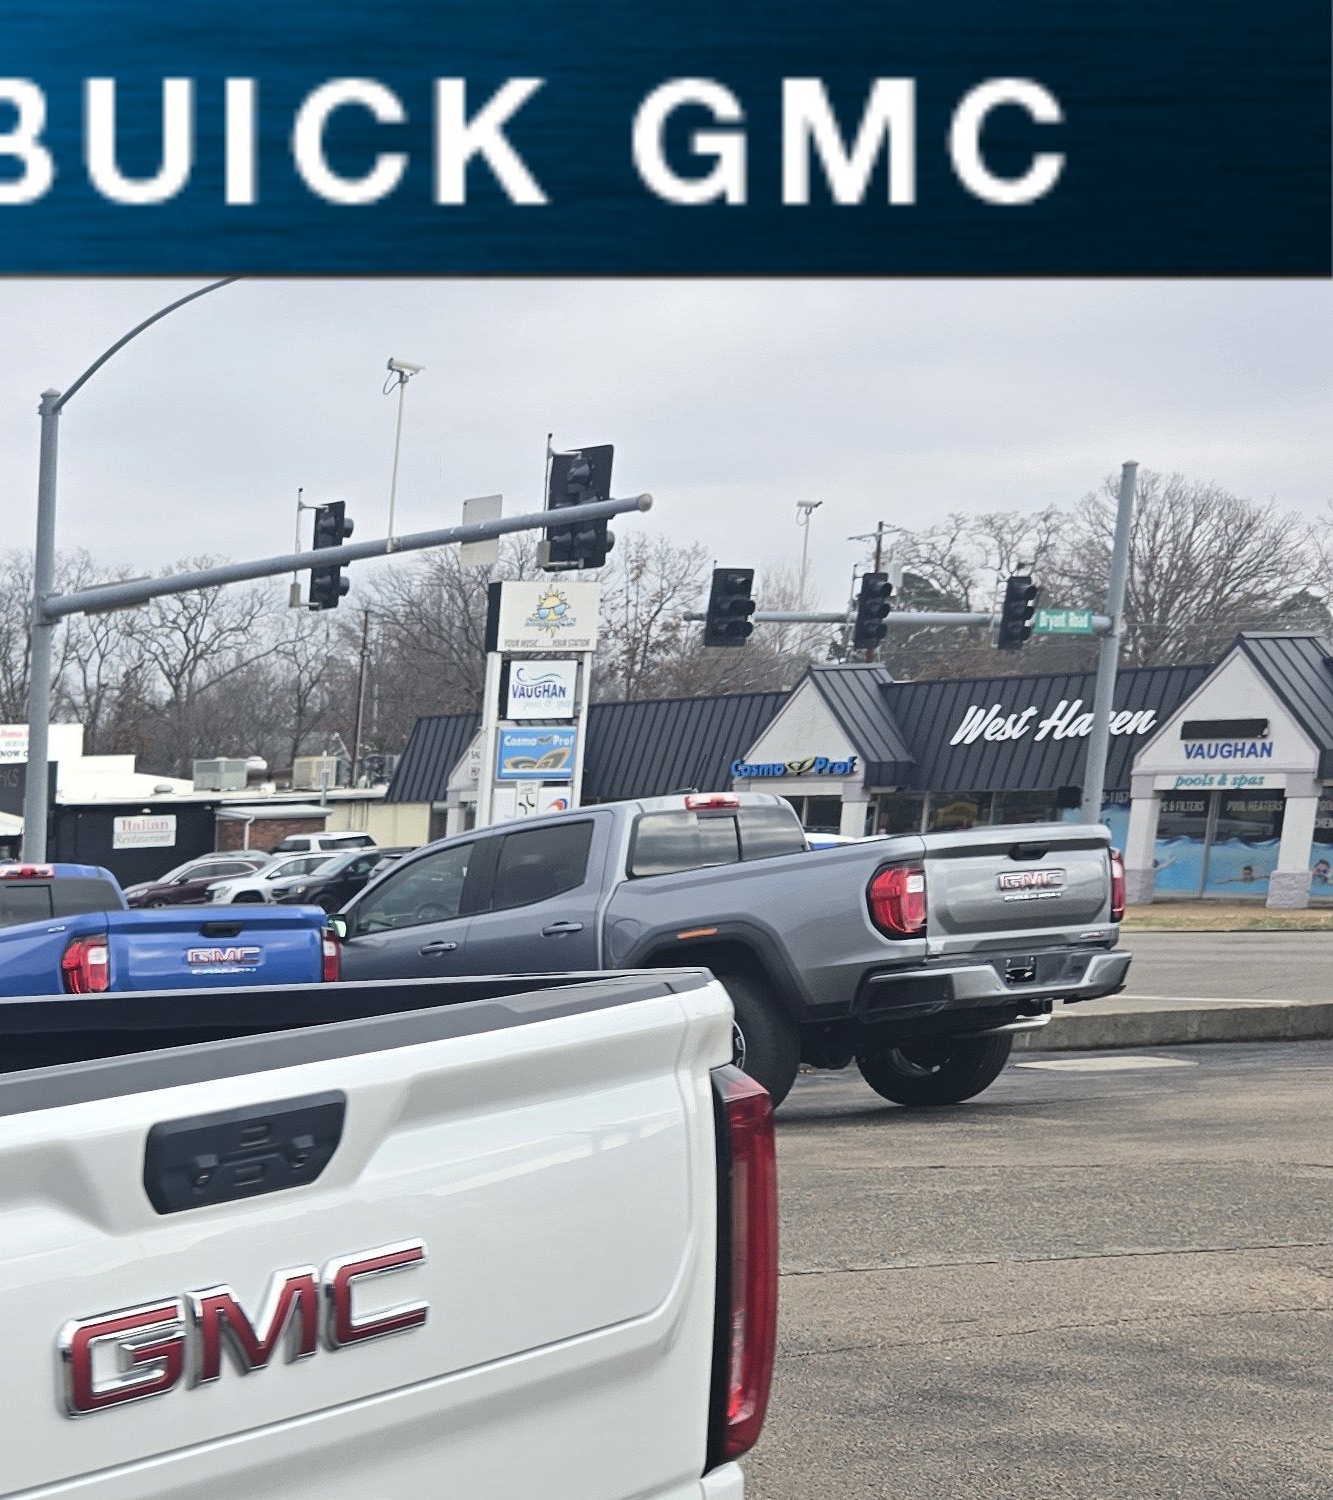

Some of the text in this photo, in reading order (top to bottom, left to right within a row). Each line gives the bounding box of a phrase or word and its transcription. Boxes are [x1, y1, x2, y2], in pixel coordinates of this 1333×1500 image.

[511, 683, 567, 699] VAUGHAN
[949, 703, 1038, 746] West
[503, 734, 537, 747] Cosmo
[1183, 740, 1274, 760] VAUGHAN
[730, 756, 858, 779] Cosmo Prof
[1173, 773, 1215, 790] pools
[1230, 774, 1265, 789] spas
[122, 819, 169, 832] Italian
[997, 868, 1067, 892] GMC
[187, 946, 261, 967] GMC
[53, 1236, 430, 1419] GMC
